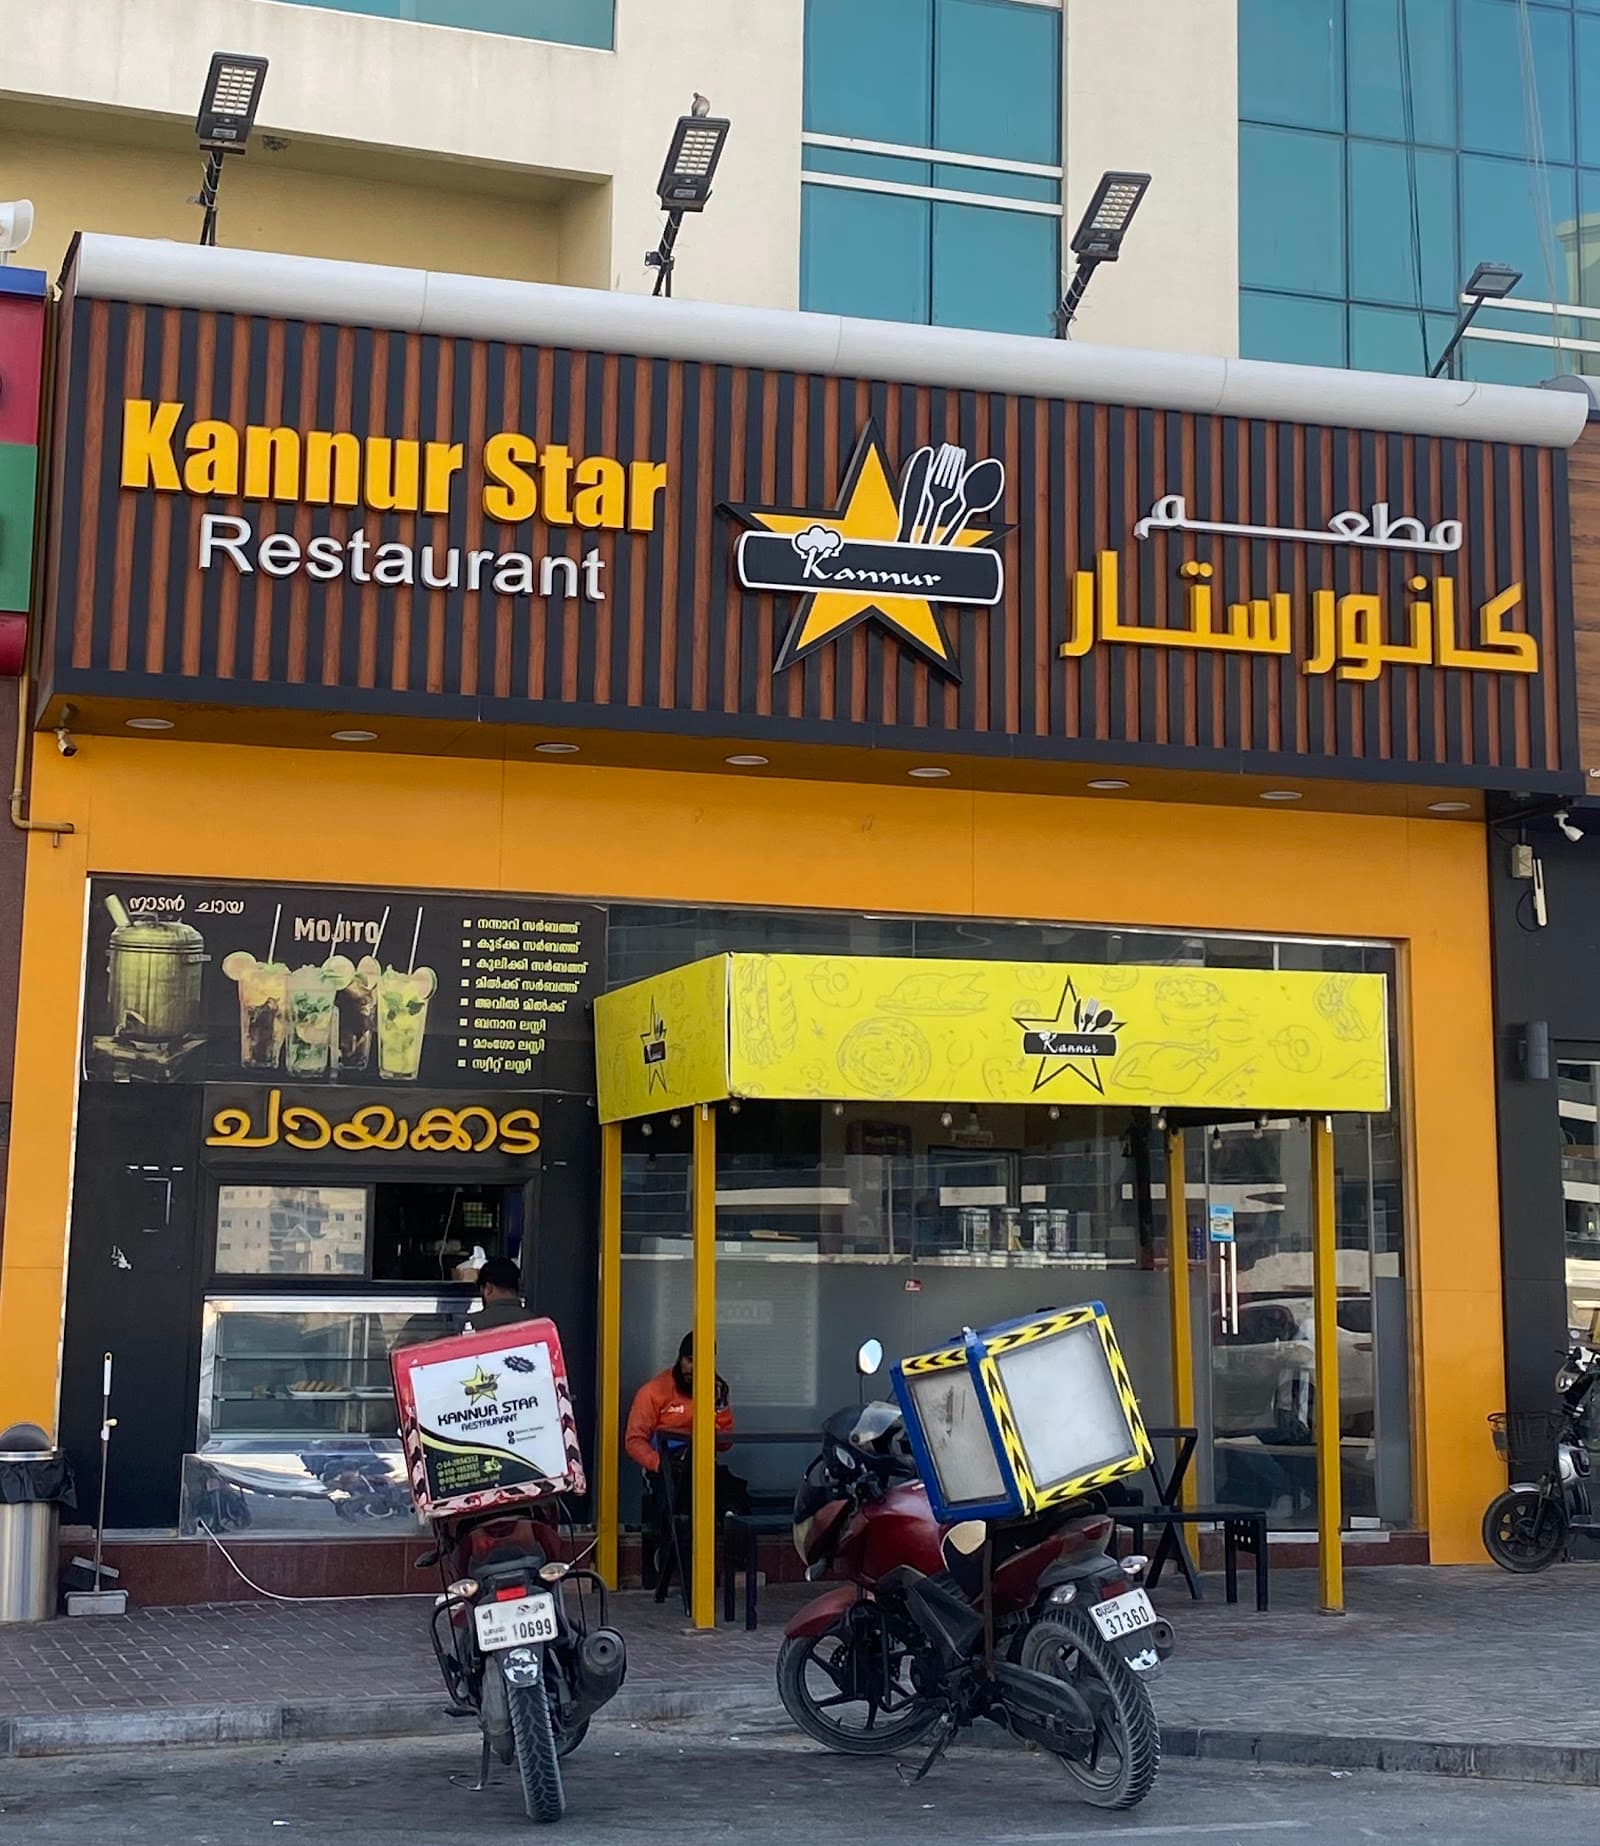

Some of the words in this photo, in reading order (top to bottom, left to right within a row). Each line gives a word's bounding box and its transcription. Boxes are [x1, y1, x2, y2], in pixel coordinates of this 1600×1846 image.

[120, 399, 463, 515] Kannur
[483, 432, 667, 533] Star
[199, 513, 606, 602] Restaurant
[802, 547, 942, 587] Kannur
[1059, 550, 1291, 658] ستار
[1302, 574, 1539, 682] كانور
[194, 899, 245, 914] ചായ
[294, 916, 380, 943] MOJITO
[205, 1088, 542, 1154] ചായക്കട
[437, 1404, 499, 1427] KANNUR
[502, 1395, 539, 1414] STAR
[1105, 1605, 1150, 1635] 37360
